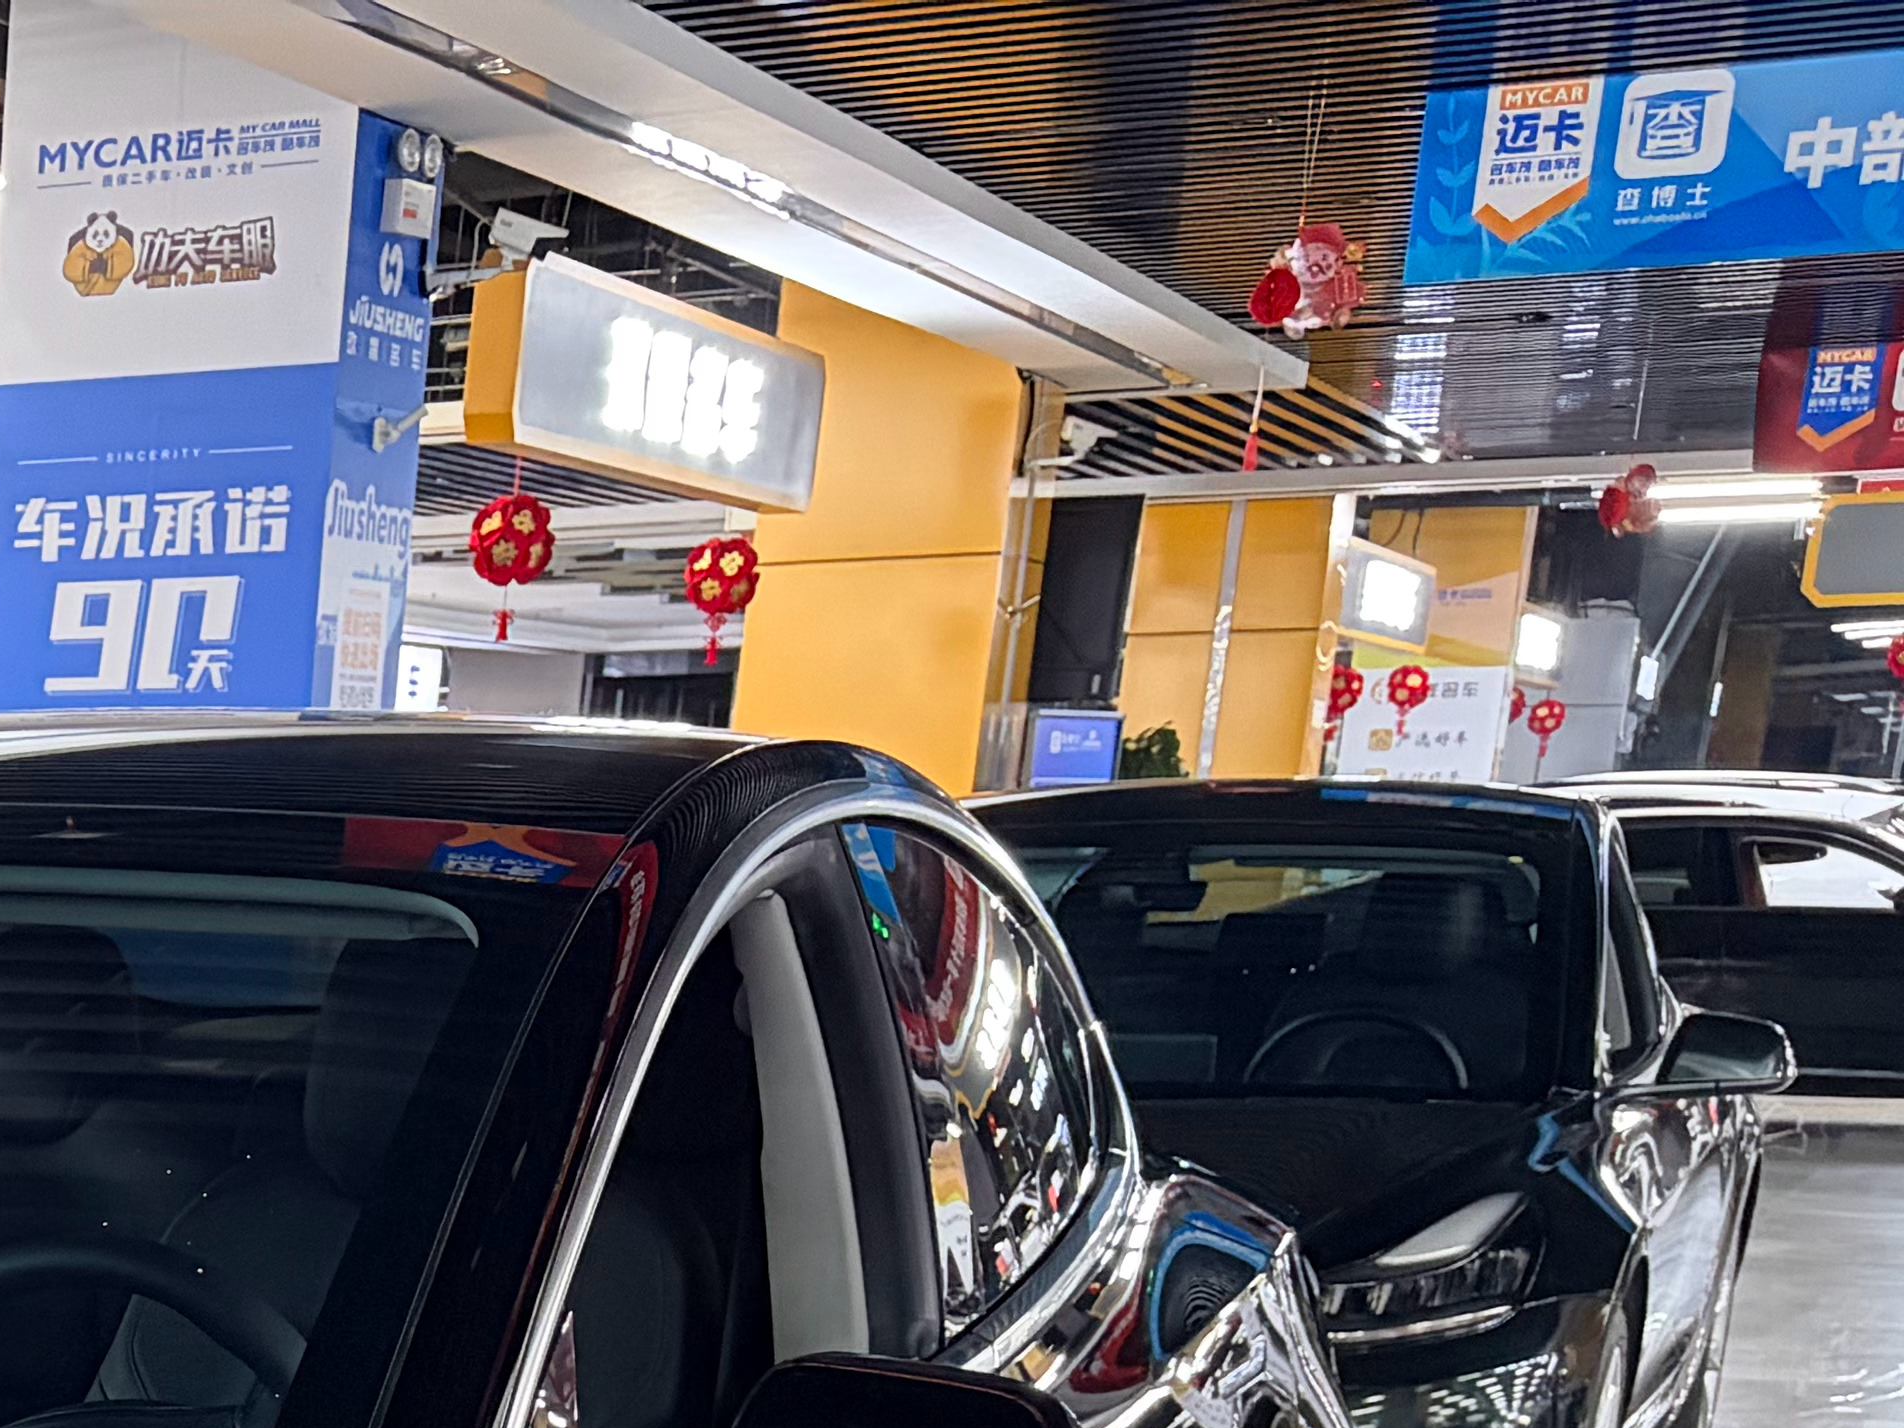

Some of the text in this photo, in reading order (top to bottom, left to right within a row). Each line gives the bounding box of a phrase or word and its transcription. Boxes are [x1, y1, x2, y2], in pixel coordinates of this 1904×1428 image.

[1504, 83, 1584, 108] MYCAR
[1495, 110, 1585, 156] 迈卡
[1615, 182, 1712, 212] 查博士
[141, 217, 276, 274] 功夫车服
[106, 448, 201, 463] SINCERITY
[14, 485, 291, 562] 车况承诺
